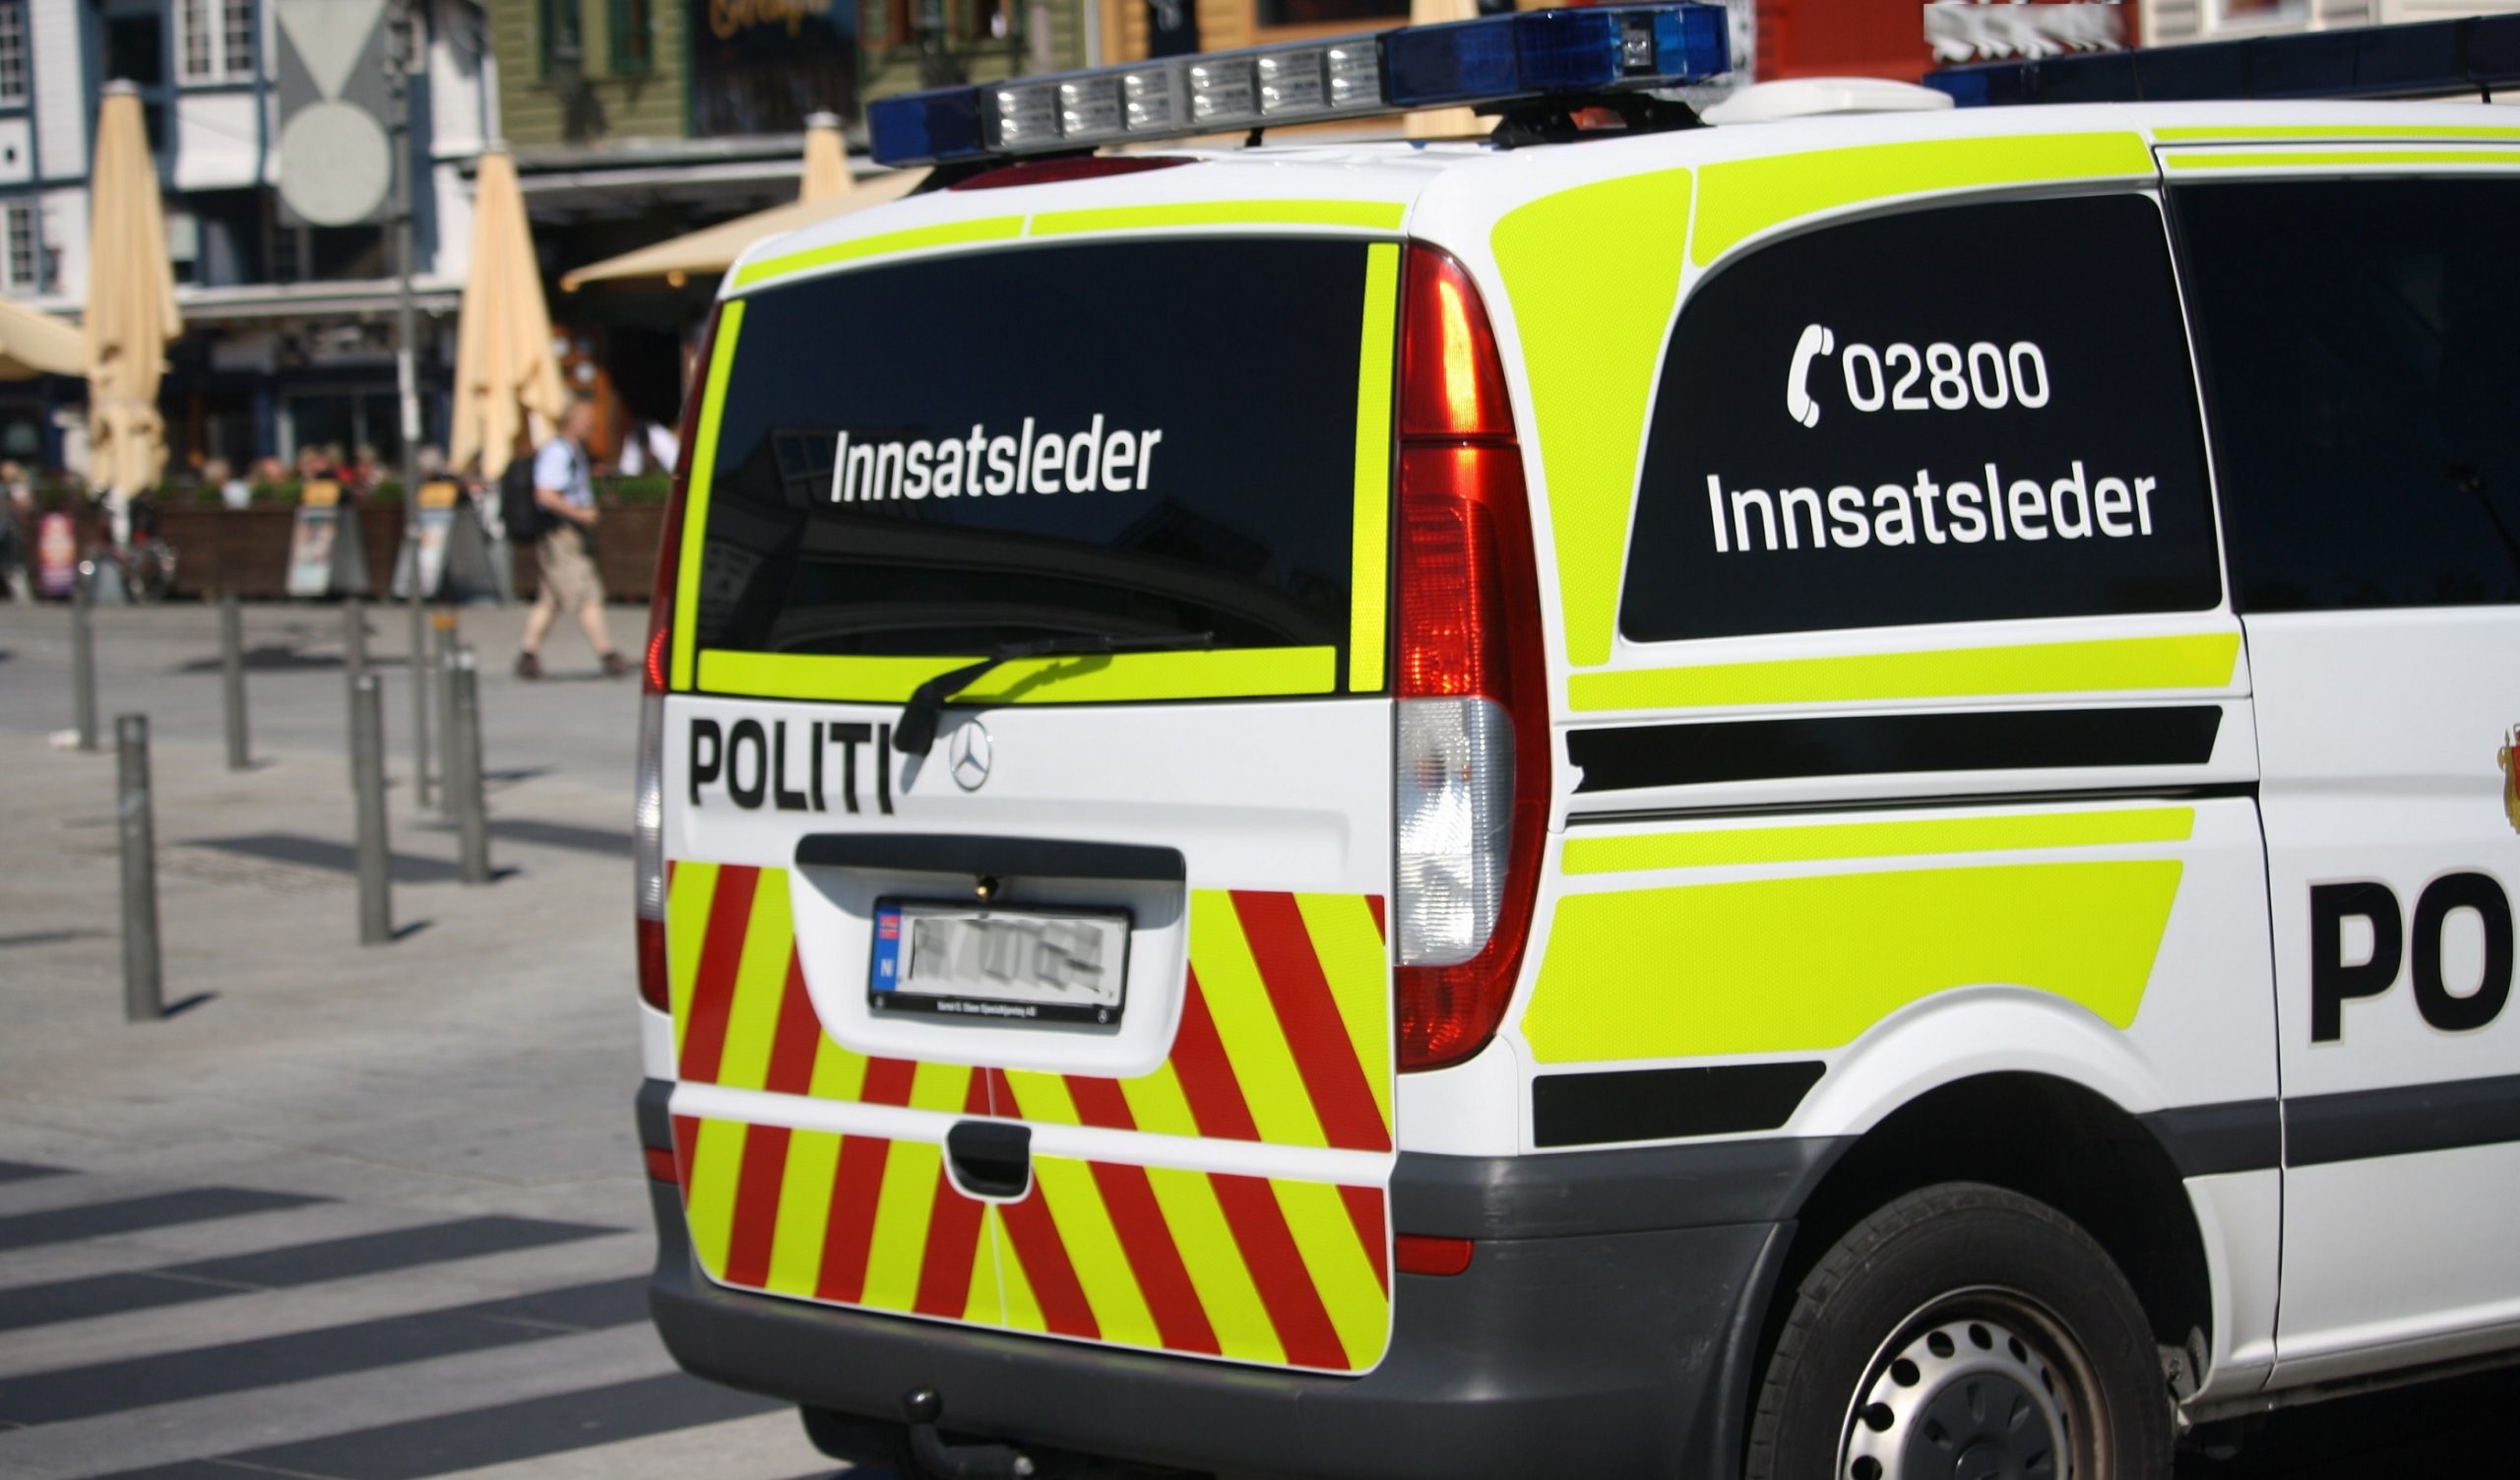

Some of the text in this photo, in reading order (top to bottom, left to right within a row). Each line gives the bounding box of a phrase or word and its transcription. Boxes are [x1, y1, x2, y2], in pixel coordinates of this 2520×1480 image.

[1841, 340, 2051, 414] 02800
[831, 412, 1163, 503] Innsatsleder
[1706, 459, 2158, 553] Innsatsleder
[689, 718, 895, 815] POLITI
[2306, 867, 2518, 1047] PO
